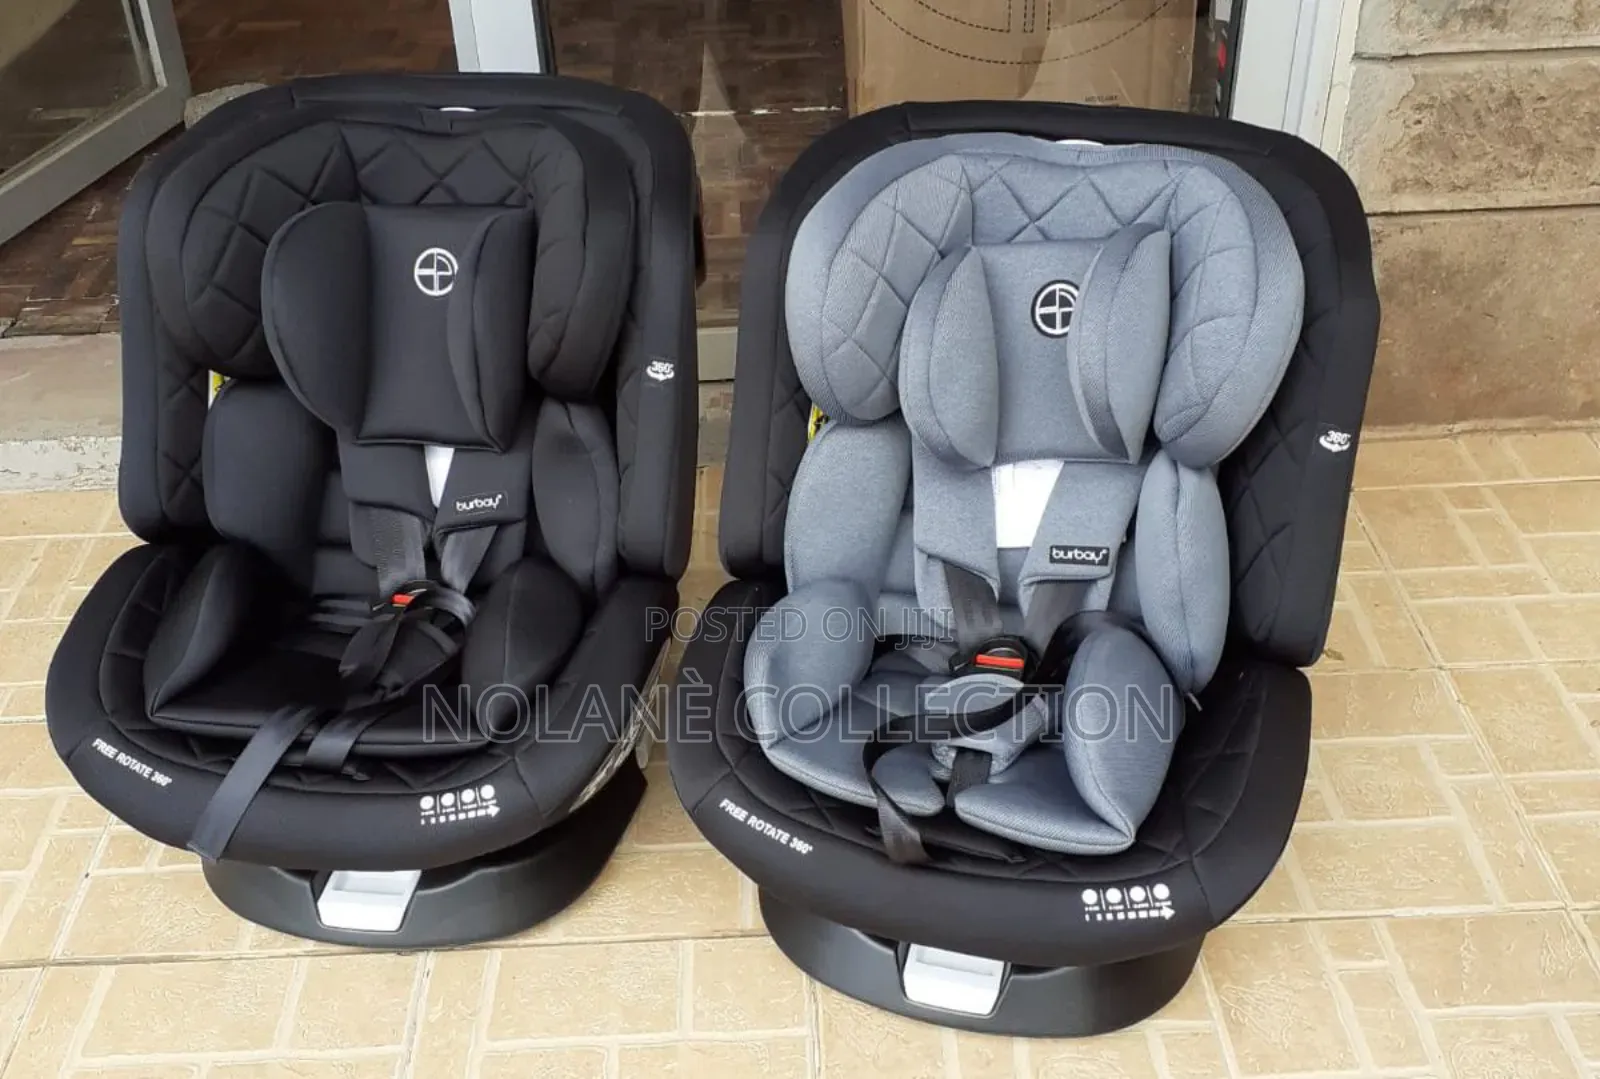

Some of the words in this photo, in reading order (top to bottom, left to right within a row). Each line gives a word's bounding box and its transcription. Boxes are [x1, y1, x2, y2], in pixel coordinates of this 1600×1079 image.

[1052, 547, 1108, 565] burbay
[91, 738, 119, 760] FREE
[115, 752, 153, 779] ROTATE
[719, 798, 749, 823] FREE
[747, 815, 791, 846] ROTATE
